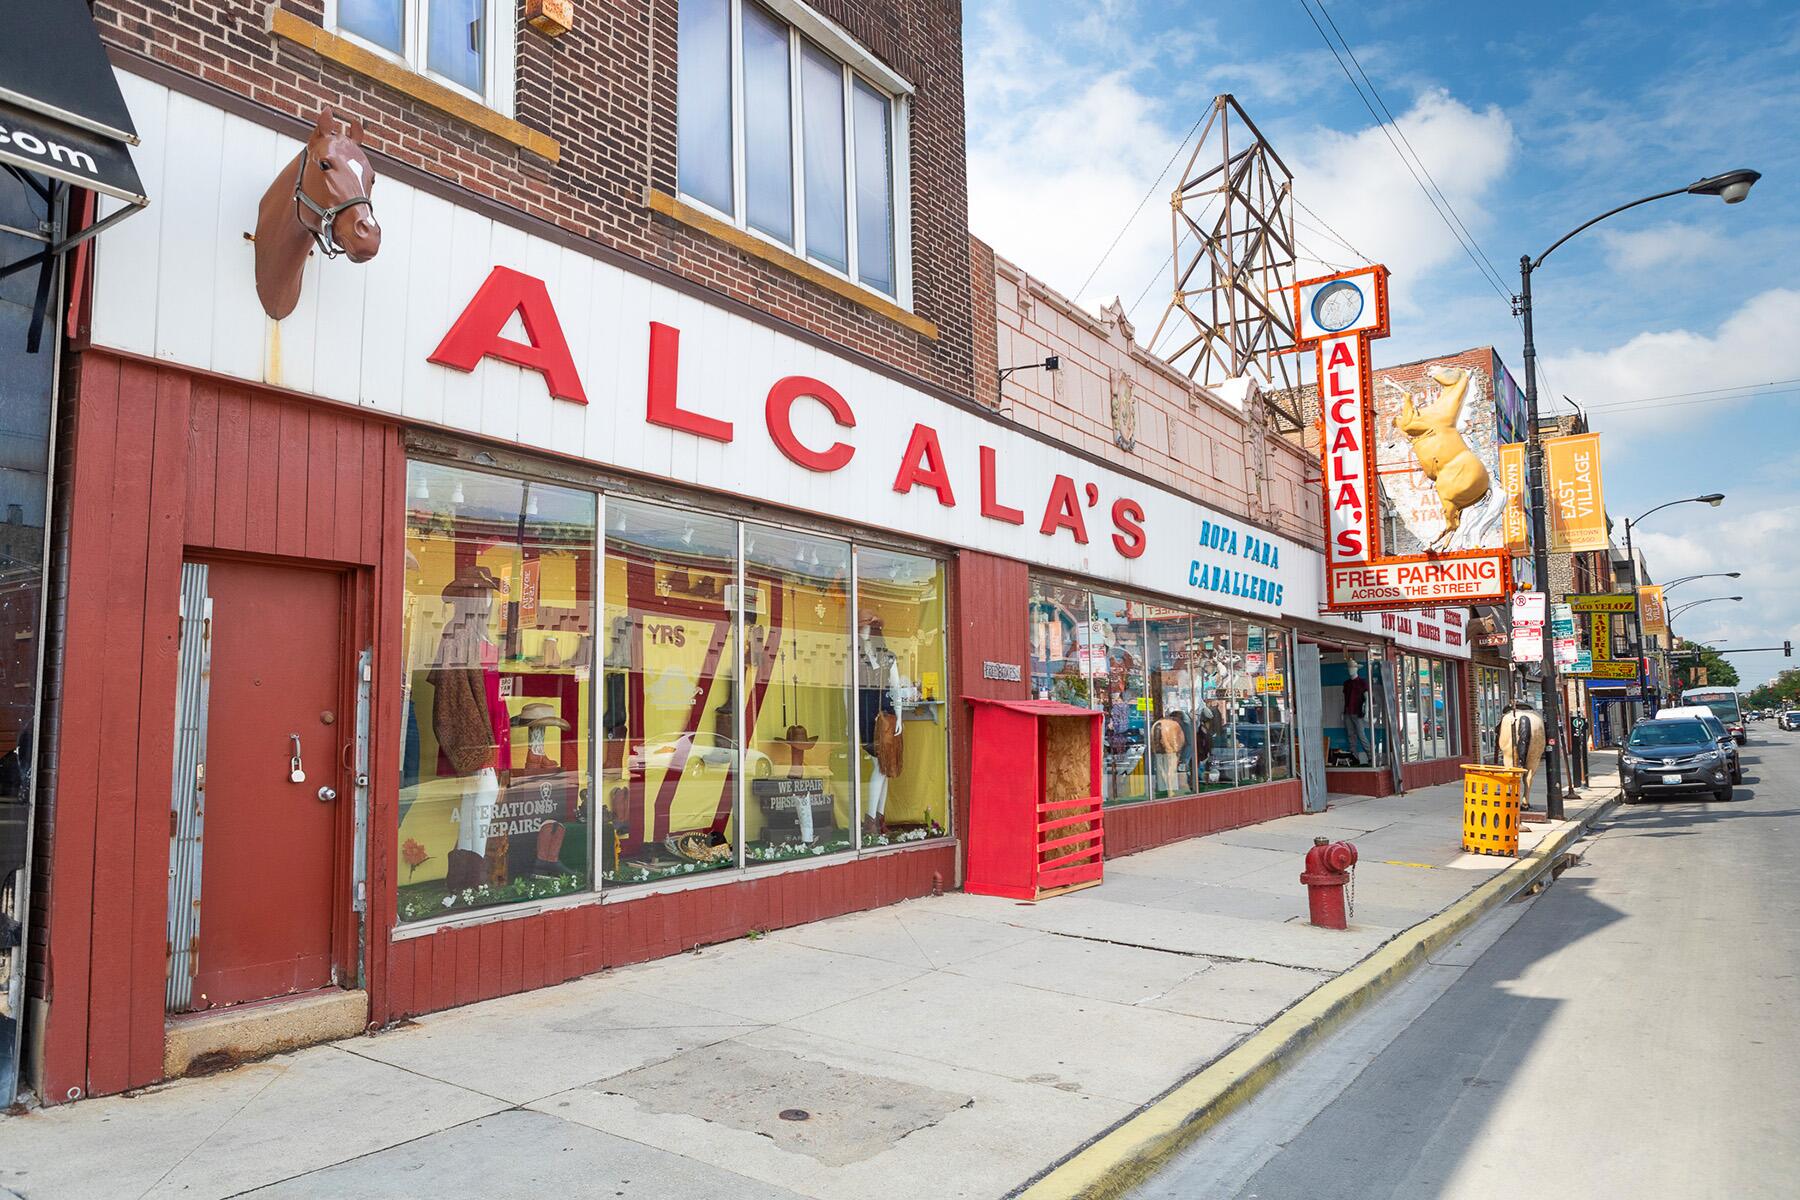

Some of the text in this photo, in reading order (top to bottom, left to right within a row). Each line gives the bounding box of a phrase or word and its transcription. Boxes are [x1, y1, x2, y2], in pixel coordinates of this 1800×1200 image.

[426, 265, 1146, 559] ALCALA'S
[1327, 342, 1363, 557] ALCALA'S
[1506, 463, 1521, 538] WEST TOWN
[1559, 480, 1576, 520] EAST
[1574, 450, 1594, 518] VILLAGE
[1199, 520, 1279, 570] ROPA PARA
[1188, 560, 1284, 607] CABALLEROS
[1336, 561, 1496, 588] FREE PARKING
[1351, 582, 1482, 600] ACROSS THE STREET
[1595, 602, 1634, 611] VELOZ
[648, 624, 686, 648] YRS
[778, 779, 824, 794] WE REPAIR
[450, 798, 553, 824] AERATIONS
[480, 817, 542, 838] REPAIRS
